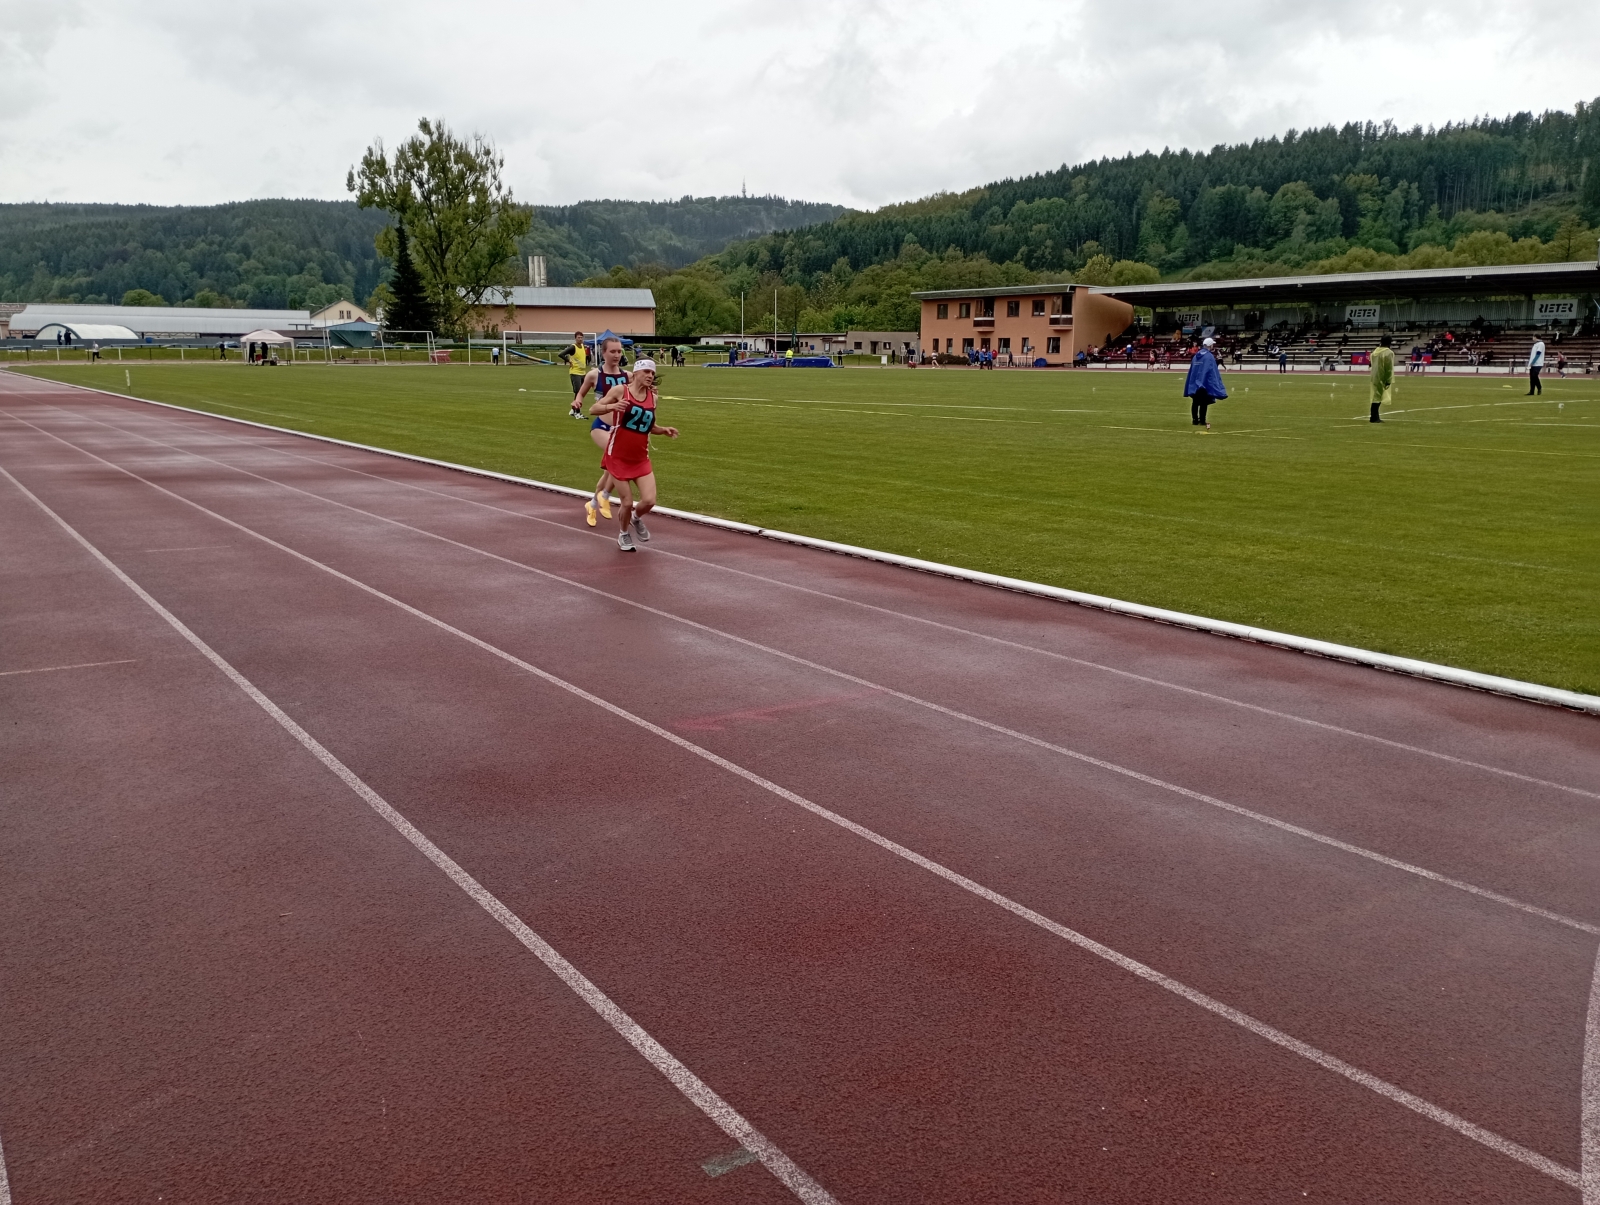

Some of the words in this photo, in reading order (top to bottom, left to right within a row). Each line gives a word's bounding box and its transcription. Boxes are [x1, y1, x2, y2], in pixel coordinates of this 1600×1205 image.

[1349, 308, 1377, 318] RIETER
[1538, 303, 1574, 313] RIETER
[626, 405, 654, 433] 29
